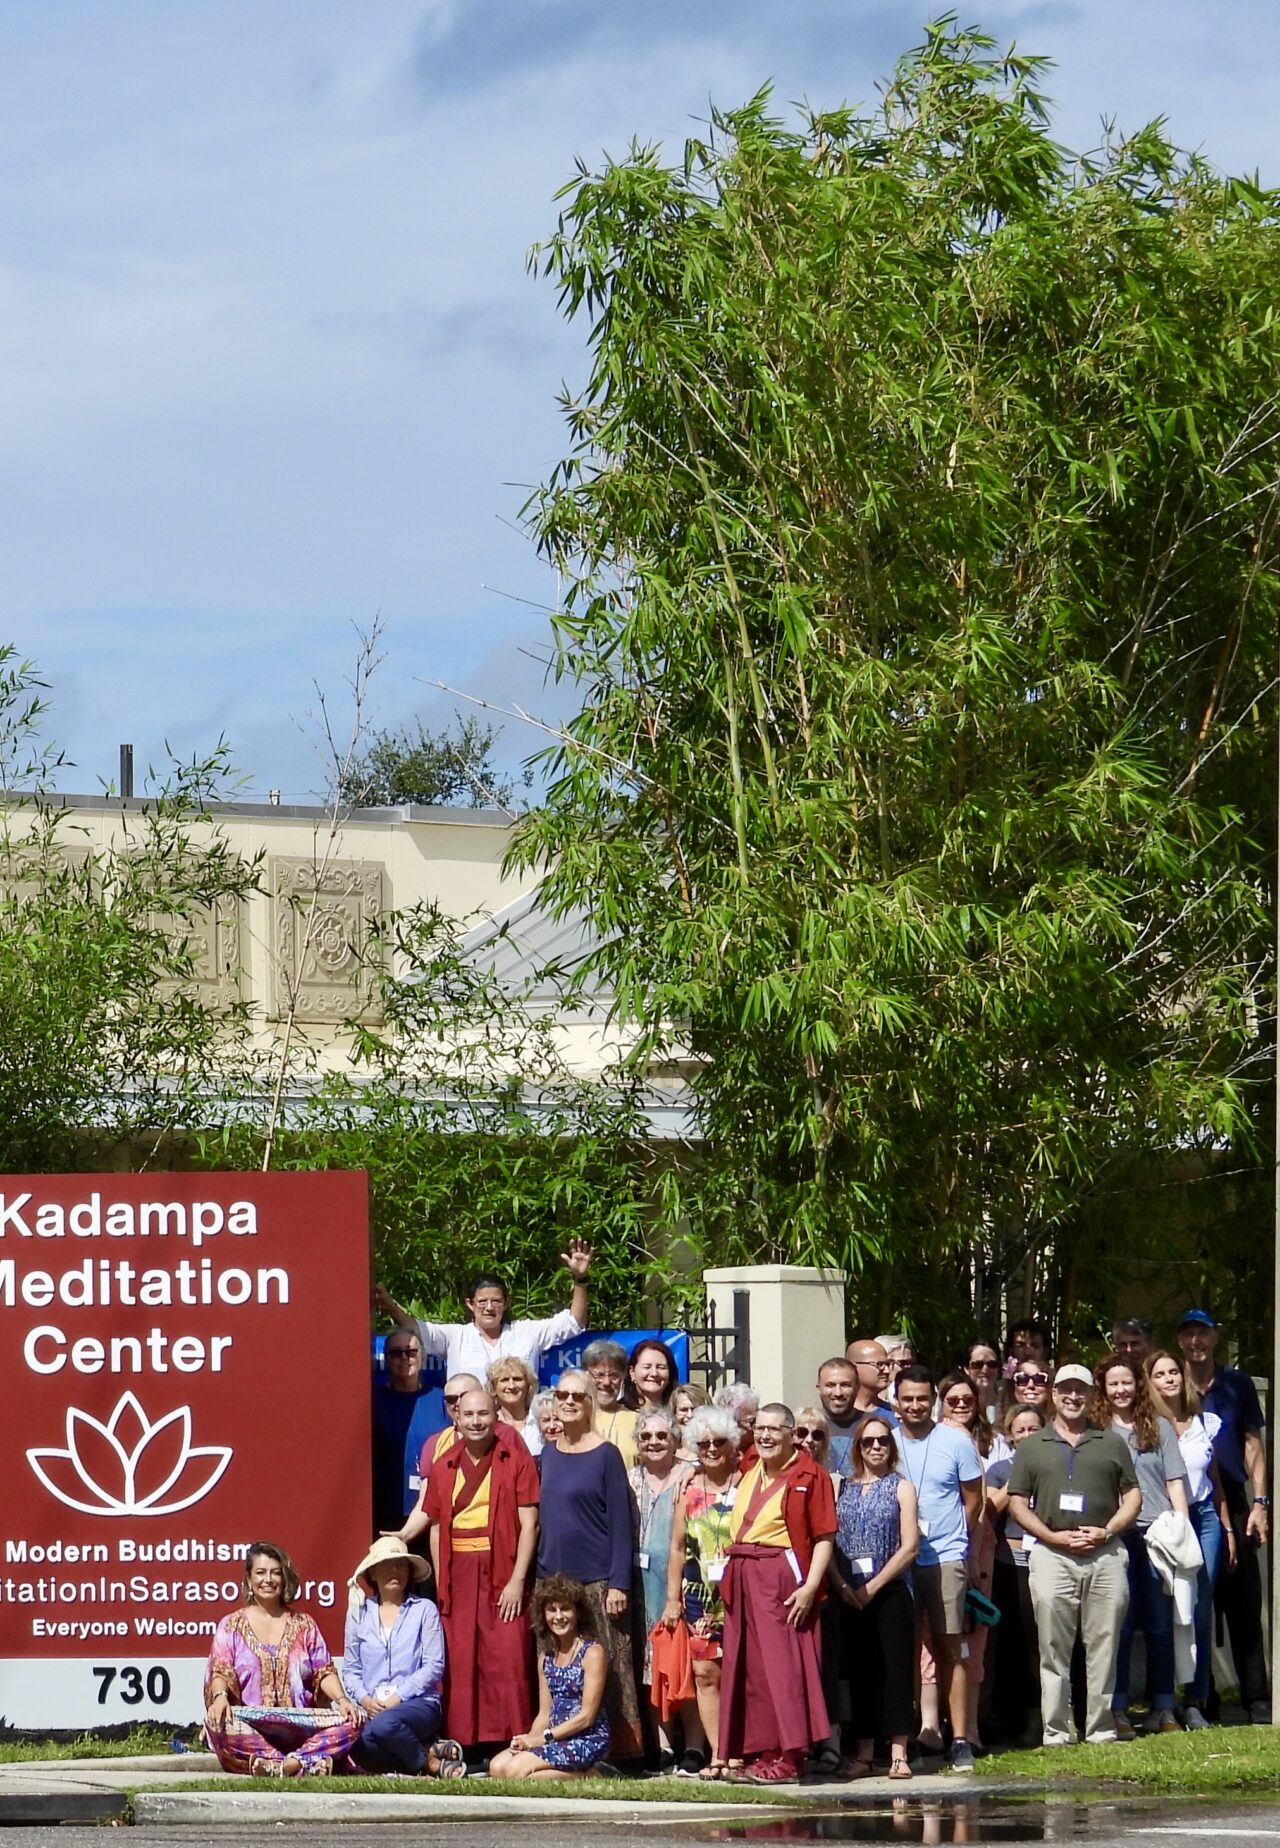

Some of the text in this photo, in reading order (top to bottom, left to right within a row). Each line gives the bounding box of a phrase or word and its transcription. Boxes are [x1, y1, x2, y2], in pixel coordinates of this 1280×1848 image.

[23, 1325, 233, 1375] Center
[5, 1538, 252, 1563] Modern Buddhism
[32, 1617, 218, 1640] Everyone Welcom
[93, 1666, 171, 1705] 730
